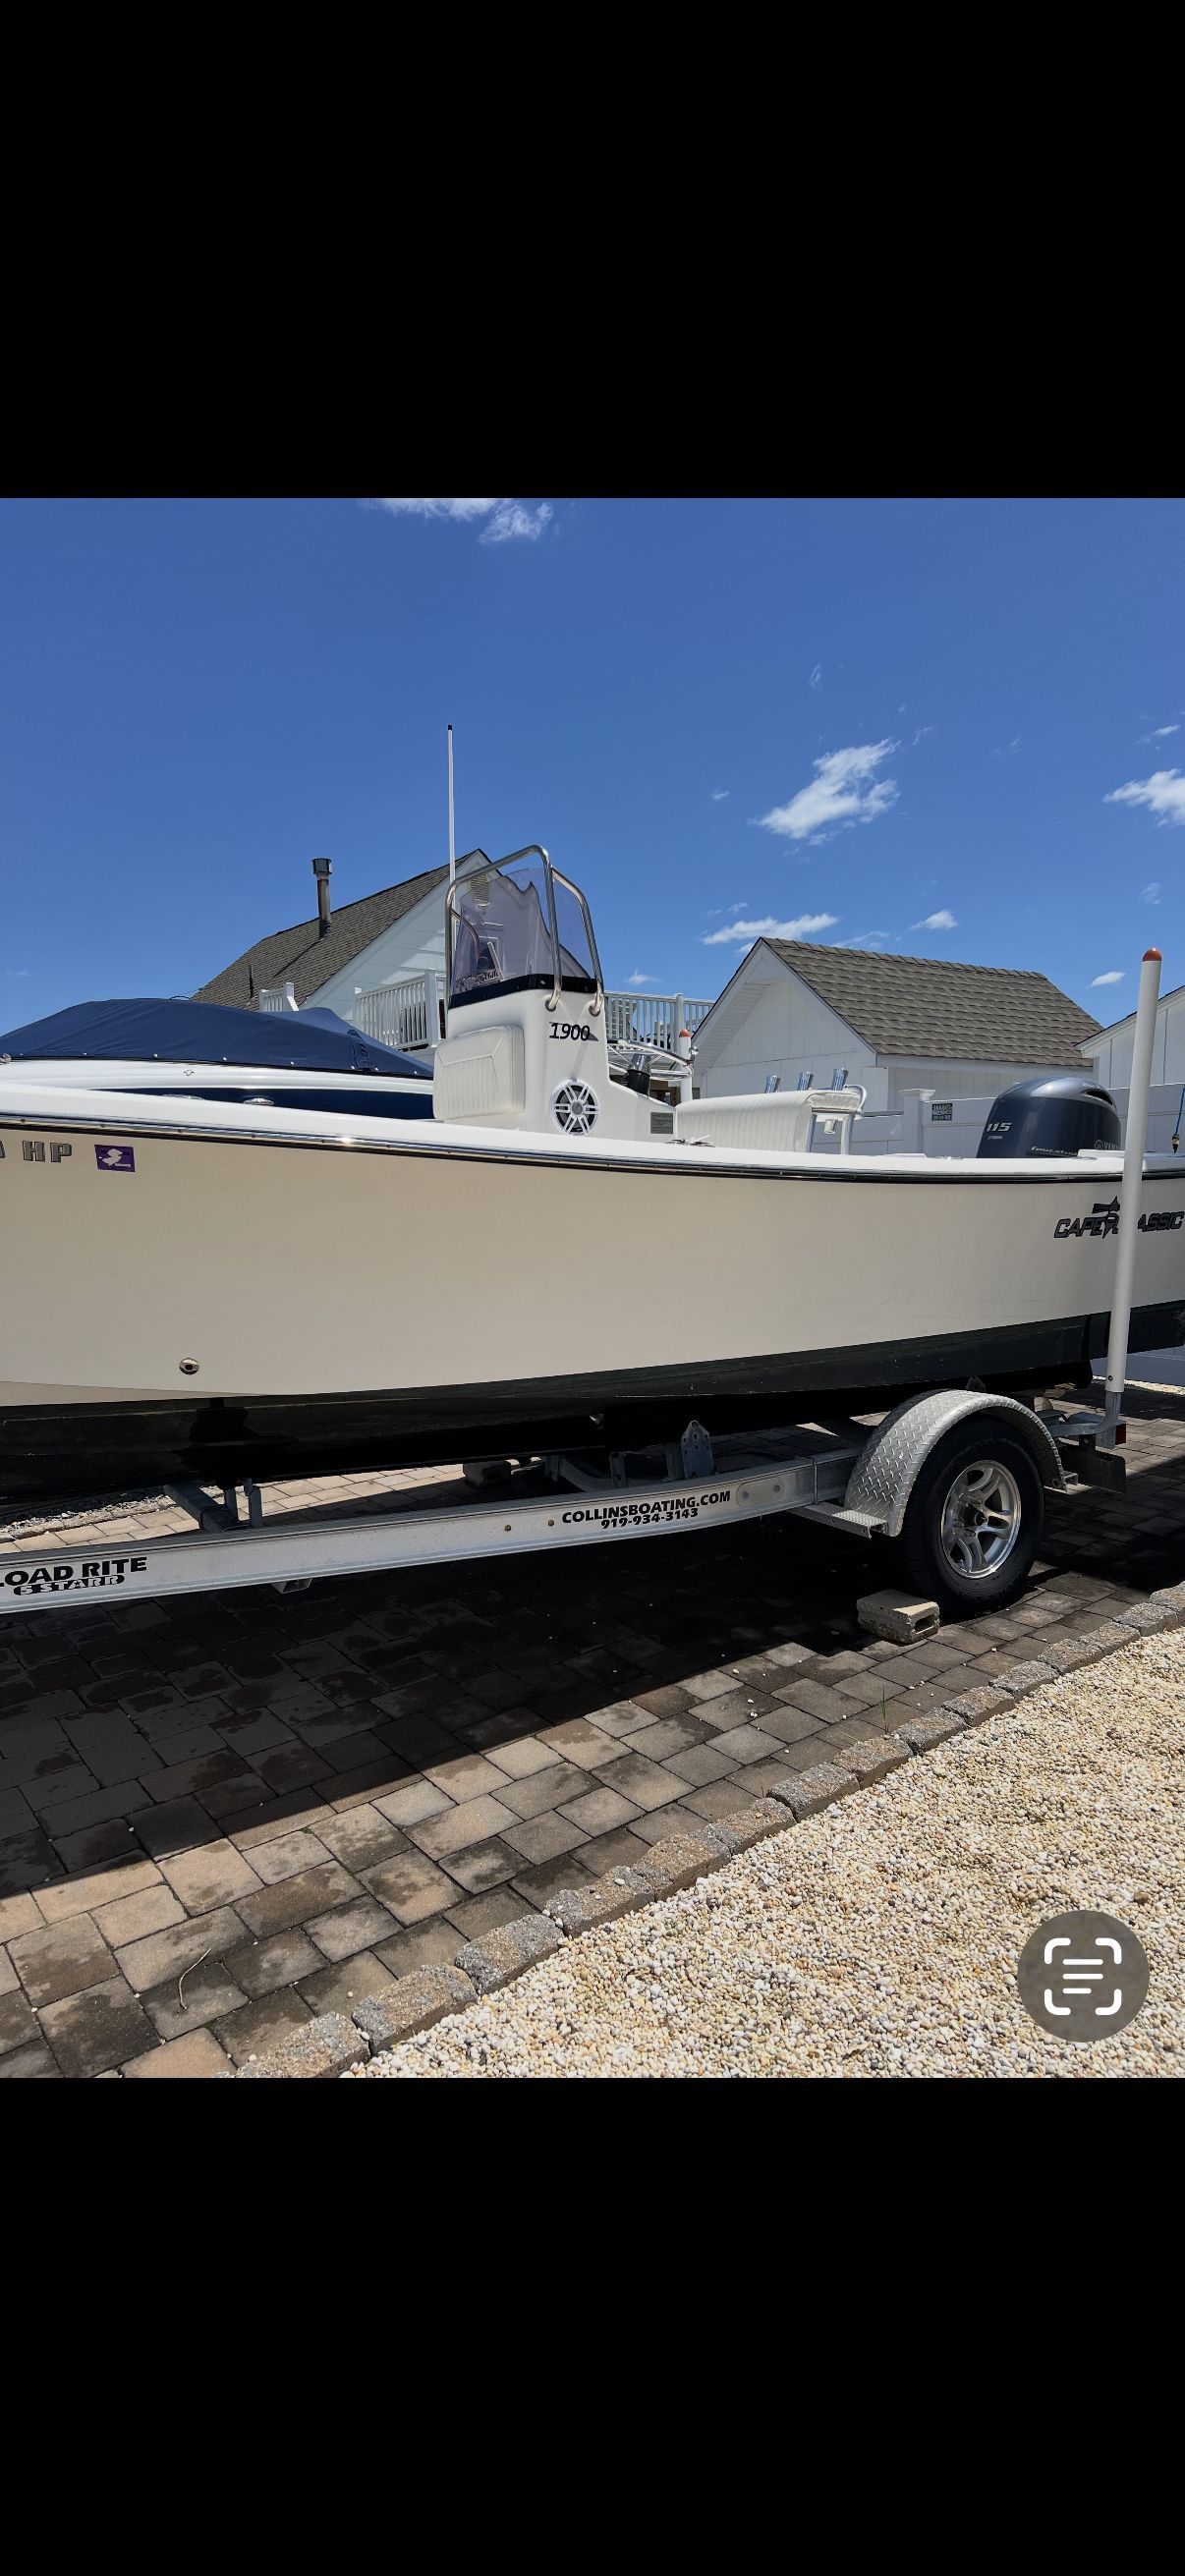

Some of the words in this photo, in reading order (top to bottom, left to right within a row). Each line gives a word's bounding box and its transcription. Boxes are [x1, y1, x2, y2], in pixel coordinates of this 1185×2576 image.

[549, 1022, 591, 1041] 1900
[986, 1122, 1012, 1133] 115
[22, 1140, 73, 1163] HP
[1053, 1215, 1105, 1239] CAPE
[562, 1490, 731, 1524] COLLINSBOATING.COM
[600, 1507, 699, 1529] 919-934-3143
[82, 1556, 147, 1578] RITE
[19, 1585, 33, 1596] 5
